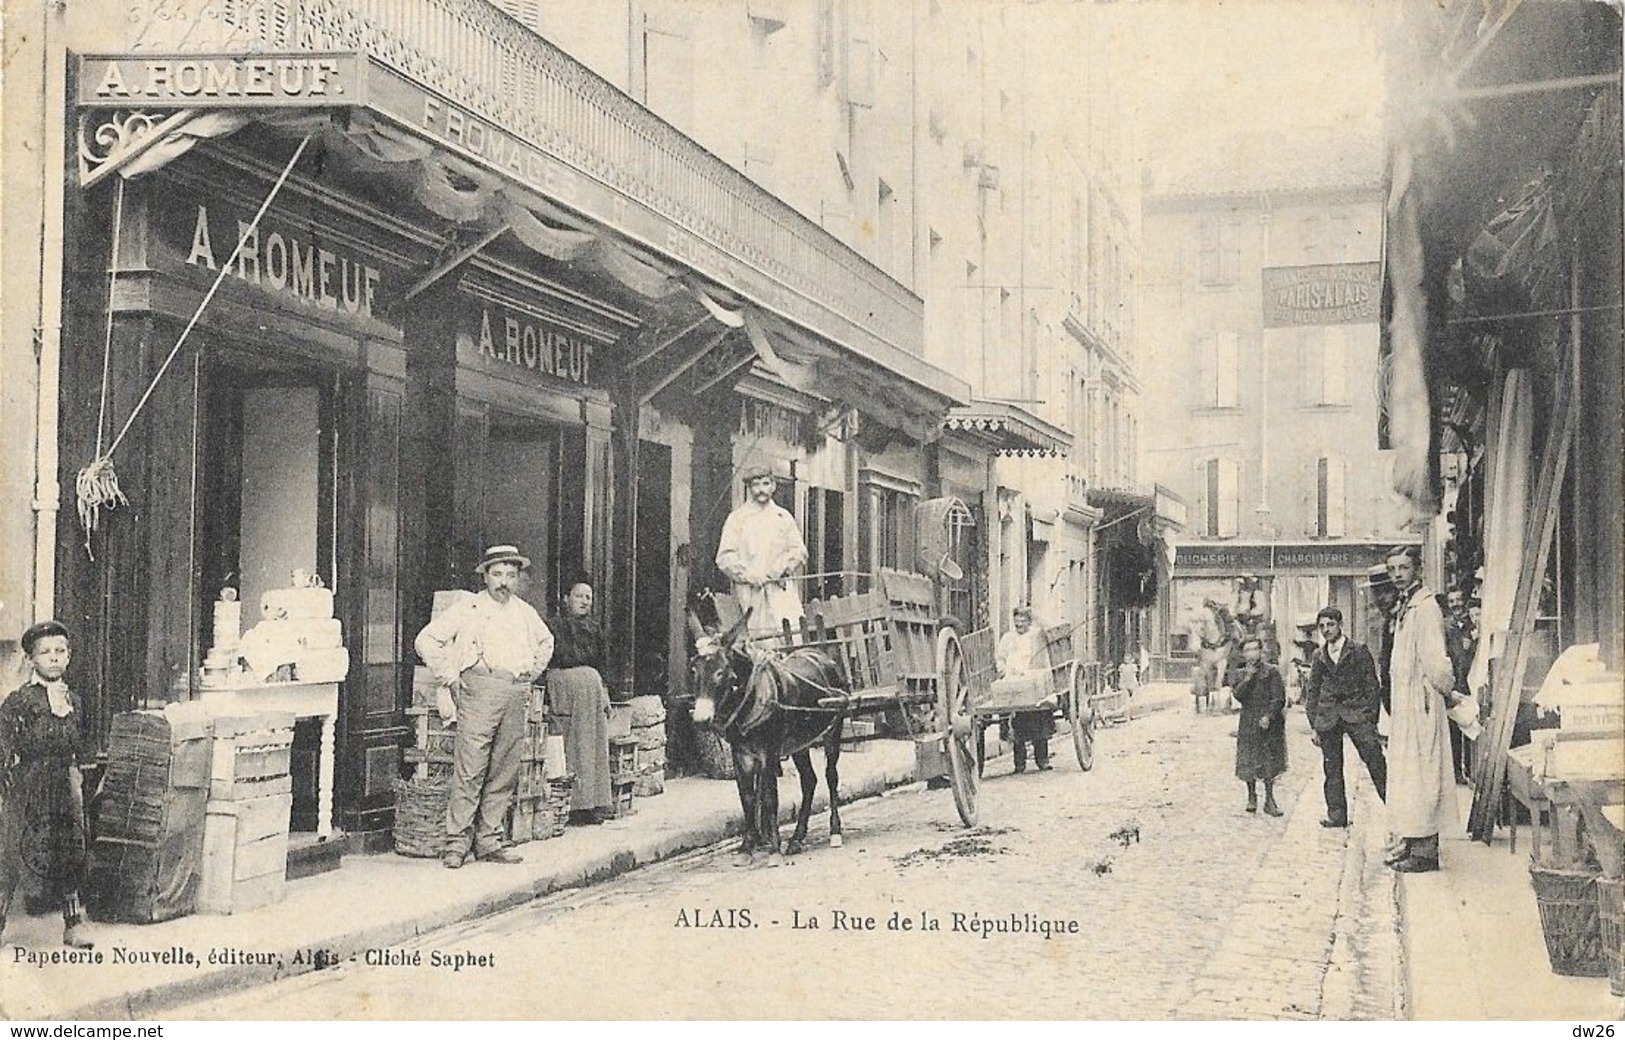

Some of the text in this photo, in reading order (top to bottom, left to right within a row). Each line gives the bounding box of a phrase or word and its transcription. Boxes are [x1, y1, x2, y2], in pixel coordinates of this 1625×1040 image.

[144, 58, 343, 97] ROMEUF.
[237, 219, 381, 319] ROMEUF
[505, 316, 594, 386] ROMEUF
[1176, 554, 1239, 565] OUCHERIE
[1277, 553, 1349, 565] CHARCUTERIE
